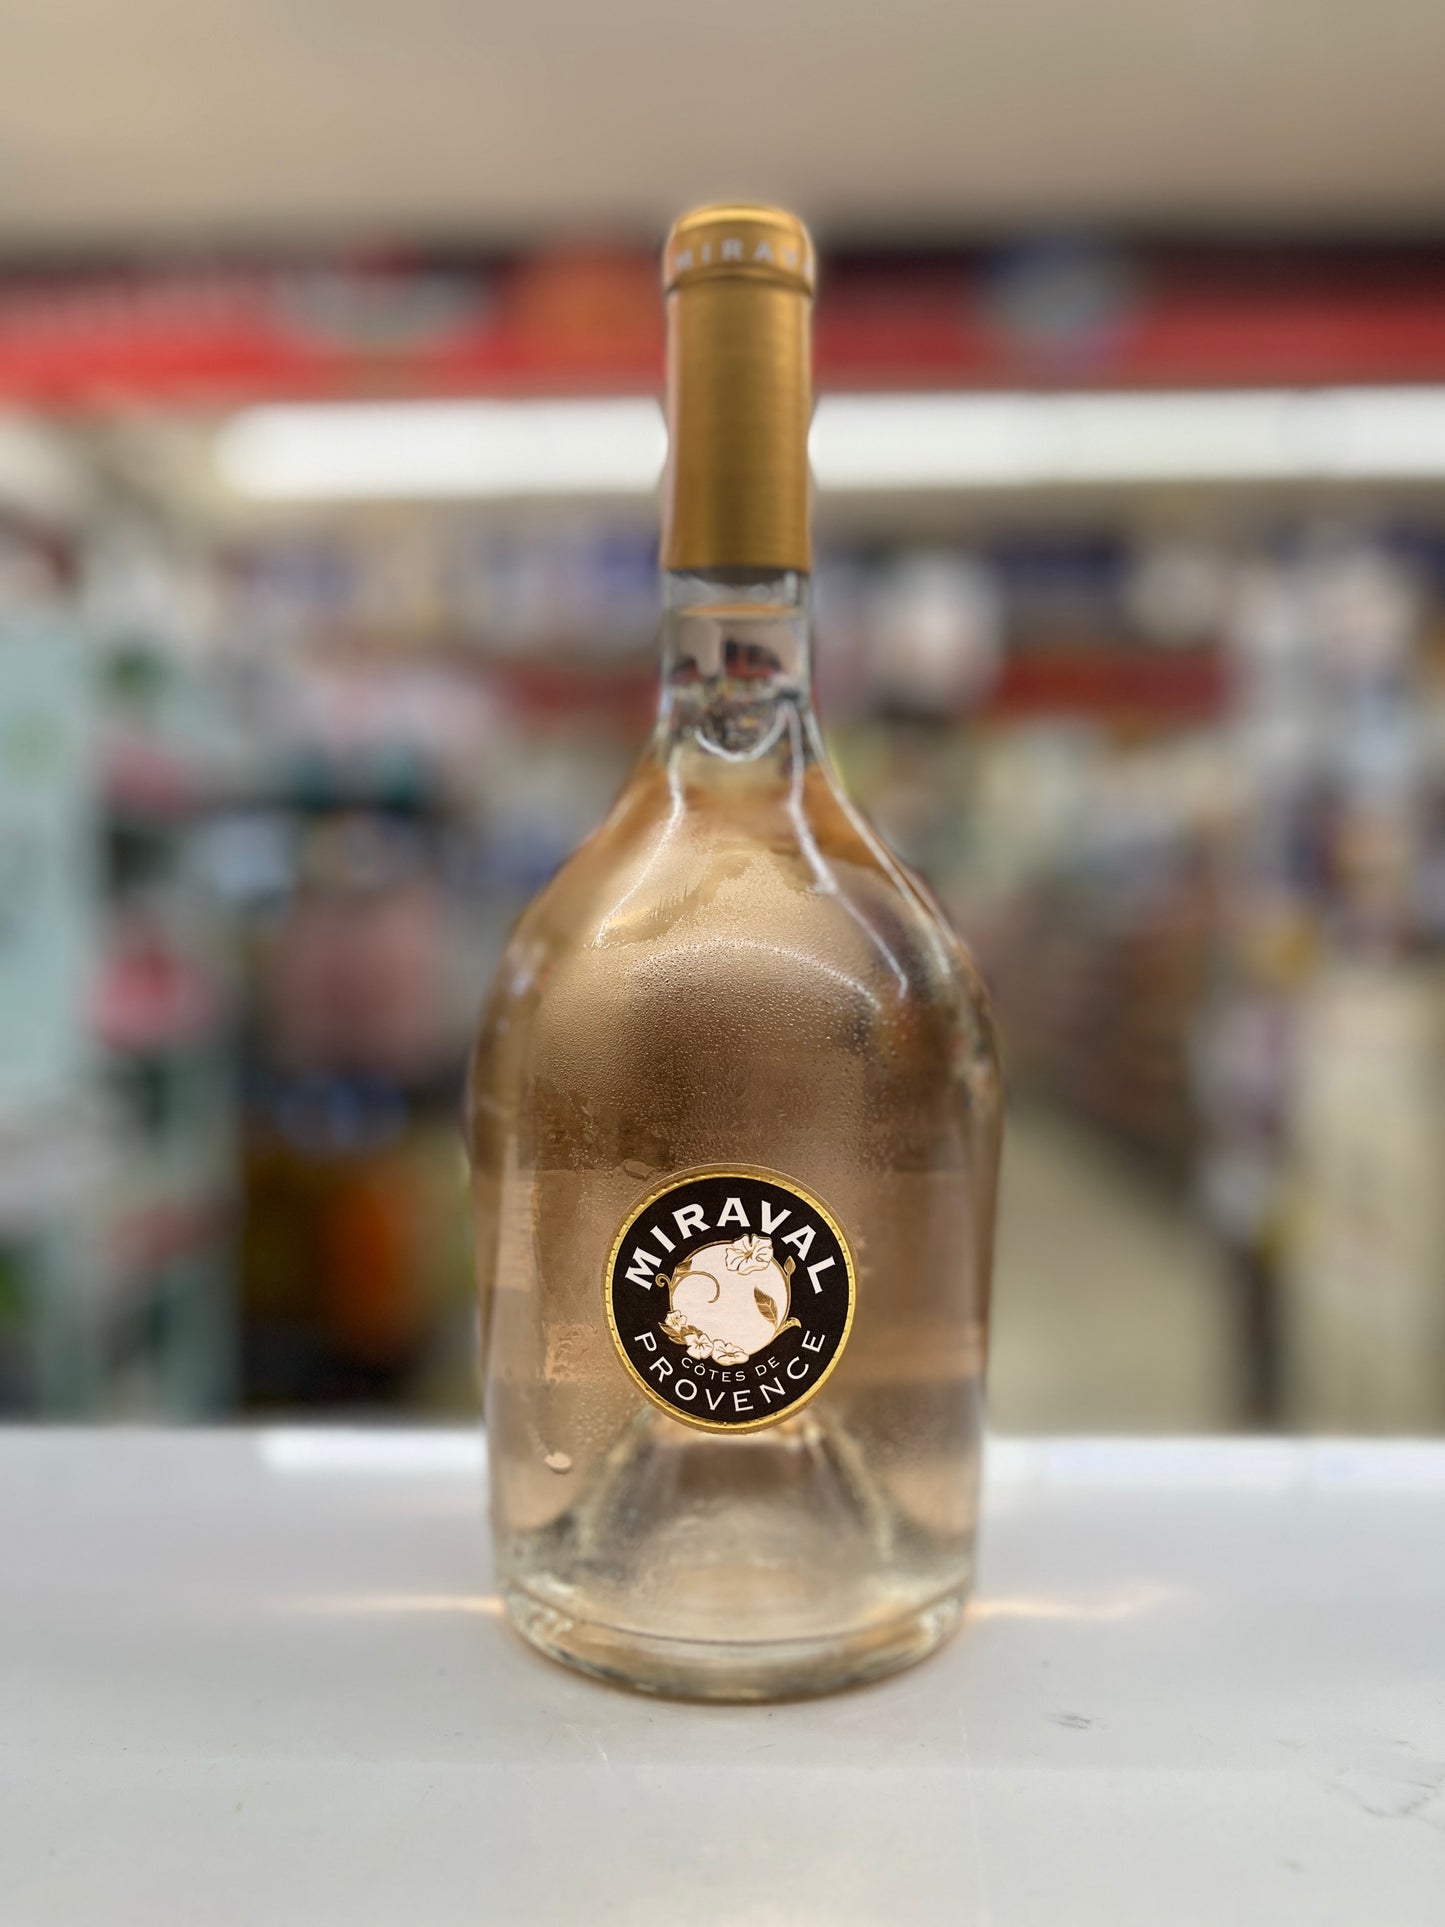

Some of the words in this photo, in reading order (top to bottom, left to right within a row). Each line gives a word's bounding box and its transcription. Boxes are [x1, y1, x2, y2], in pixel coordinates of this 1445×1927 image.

[625, 1197, 835, 1294] MIRAVAL
[634, 1330, 825, 1412] PROVENCE
[681, 1357, 746, 1382] CÔTES
[755, 1356, 780, 1376] DE
